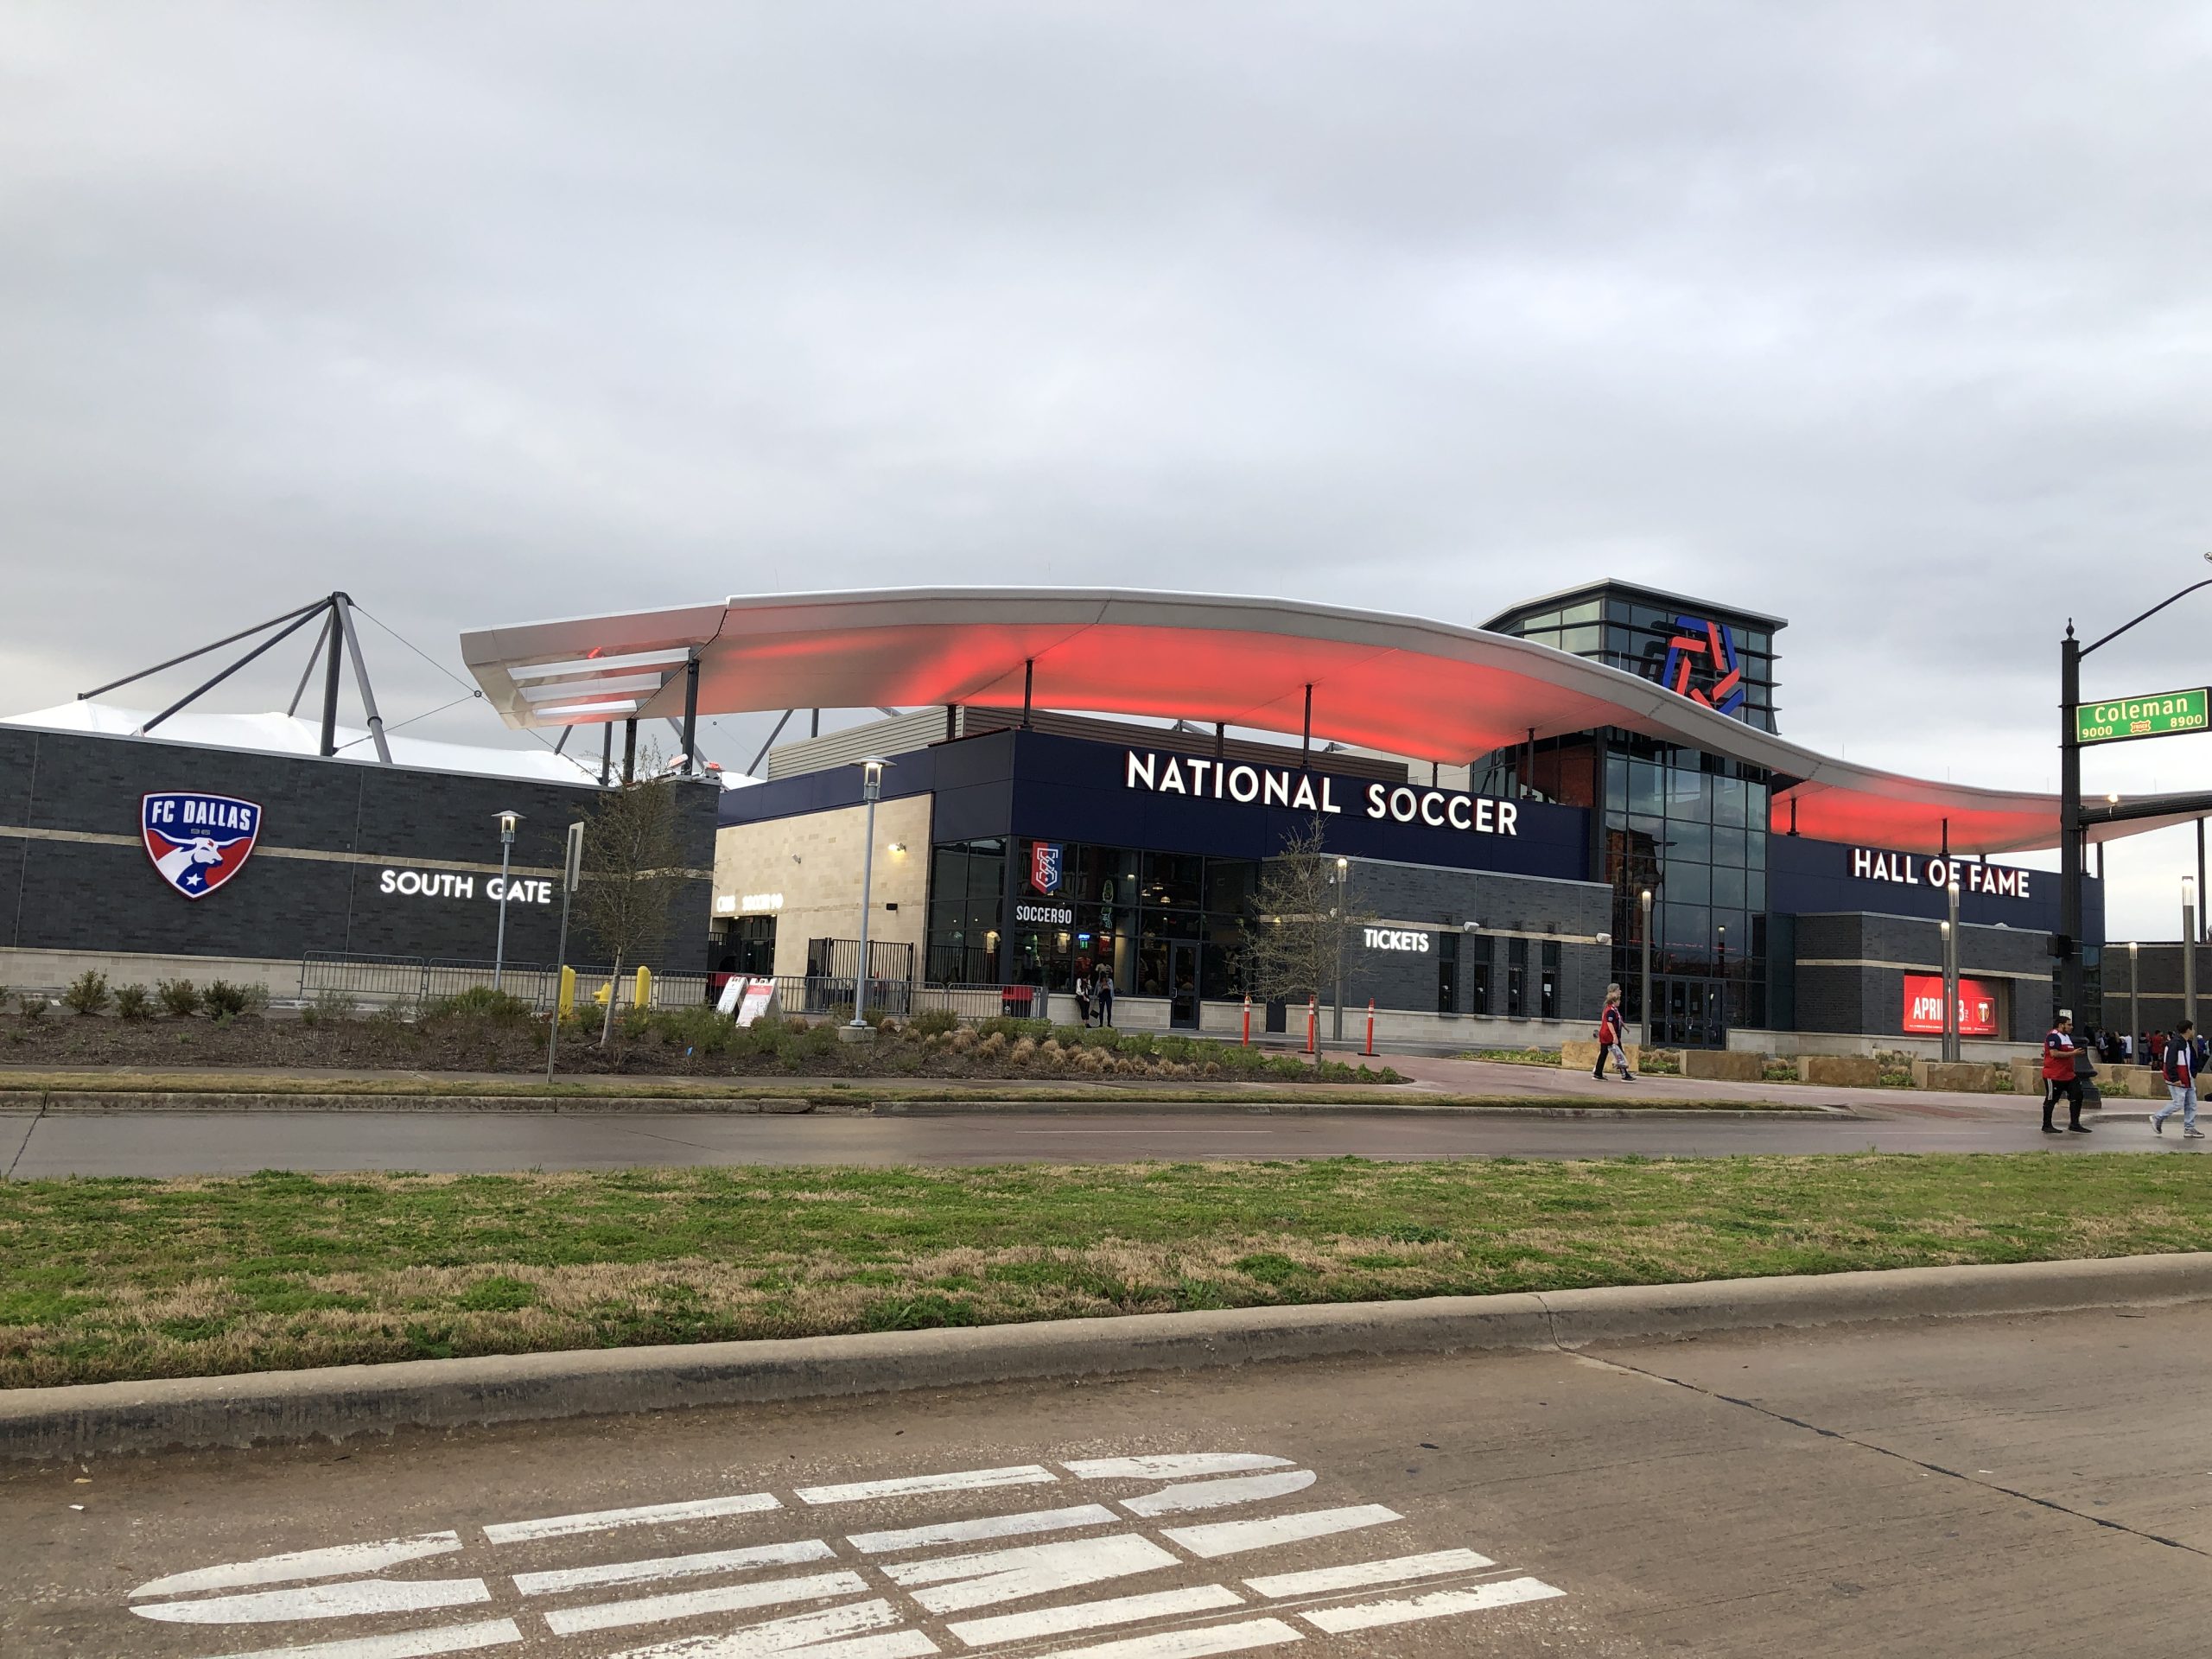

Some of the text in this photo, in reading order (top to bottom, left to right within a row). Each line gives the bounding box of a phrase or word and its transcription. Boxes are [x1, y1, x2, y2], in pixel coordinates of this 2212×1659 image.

[2094, 697, 2188, 723] Coleman
[2170, 715, 2202, 728] 8900
[2082, 726, 2113, 738] 9000
[1127, 750, 1518, 836] NATIONAL SOCCER
[152, 800, 251, 831] FC DALLAS
[380, 869, 552, 904] SOUTH GATE
[1854, 849, 2030, 899] HALL OF FAME
[1016, 905, 1072, 925] SOCCER90
[1363, 928, 1429, 952] TICKETS
